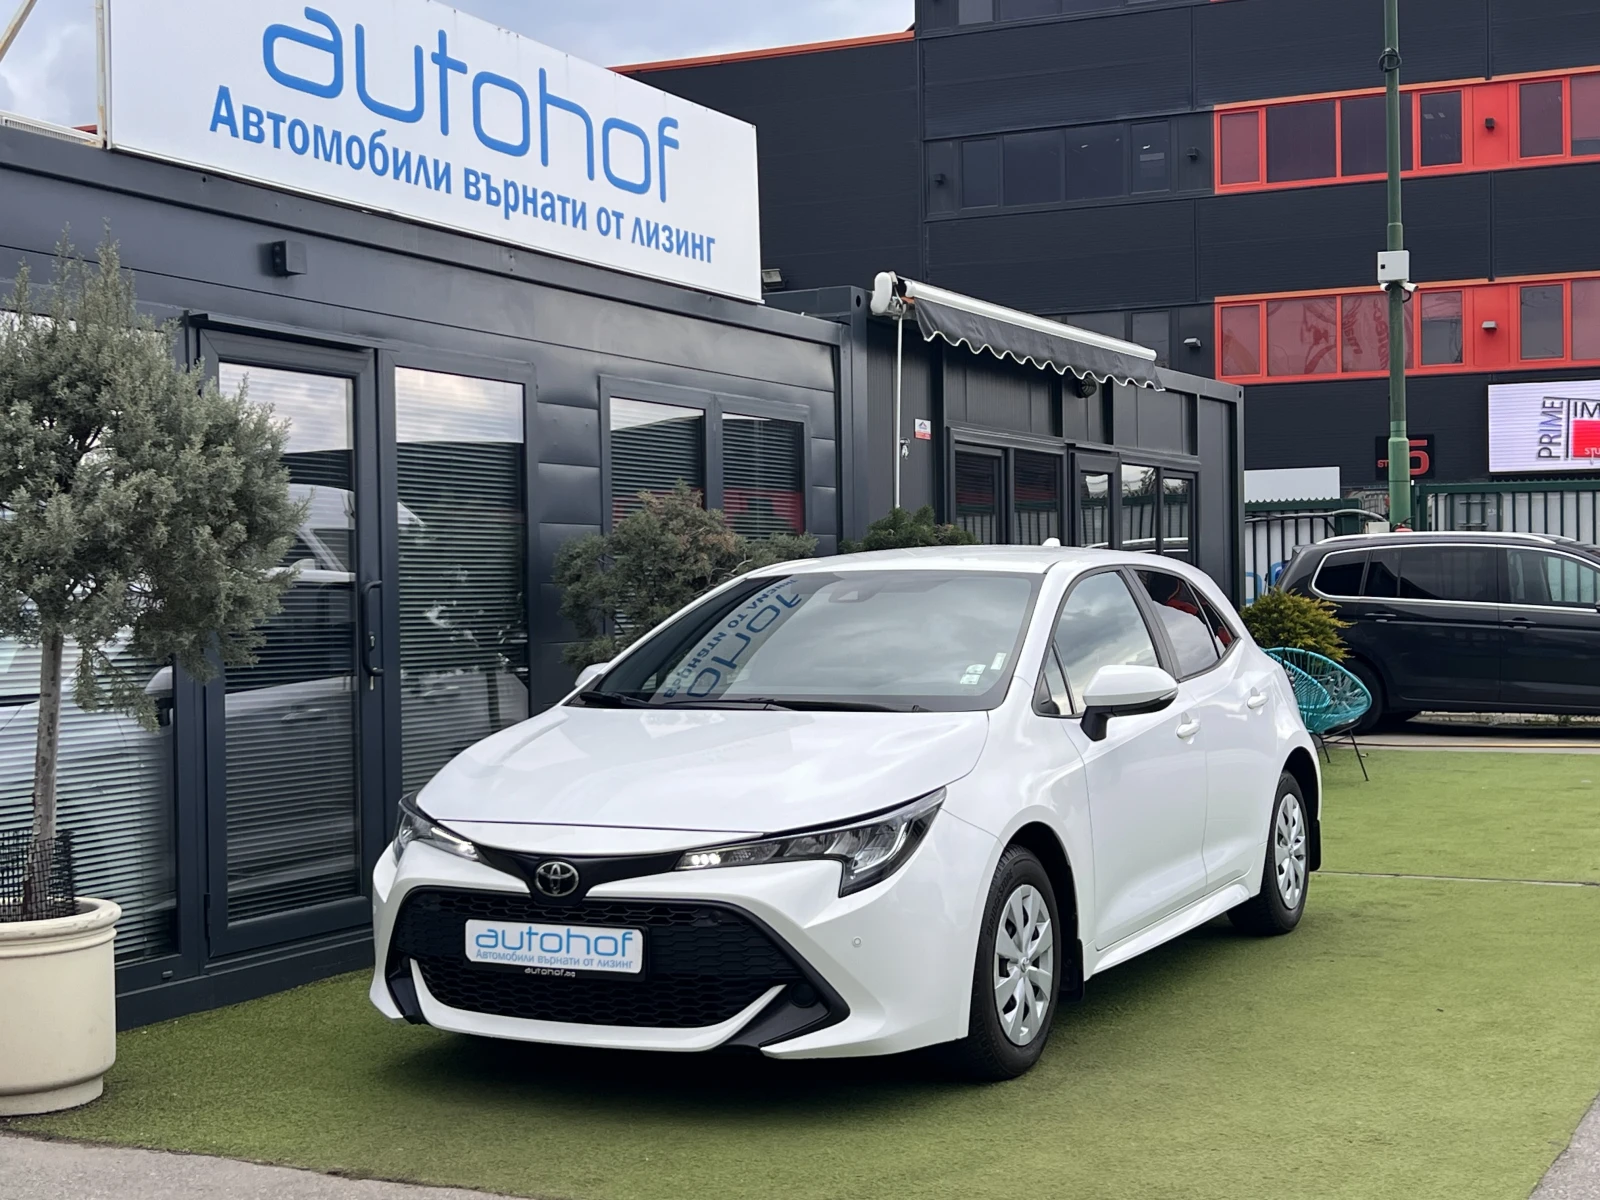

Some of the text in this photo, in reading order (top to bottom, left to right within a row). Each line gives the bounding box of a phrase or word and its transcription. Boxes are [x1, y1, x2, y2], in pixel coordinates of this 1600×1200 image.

[262, 6, 680, 203] autohof
[209, 85, 716, 263] Автомобили върнати от лизинг
[1537, 400, 1564, 458] PRIME
[475, 925, 634, 957] autohof
[476, 949, 634, 969] Автомобили върнати от лизинг
